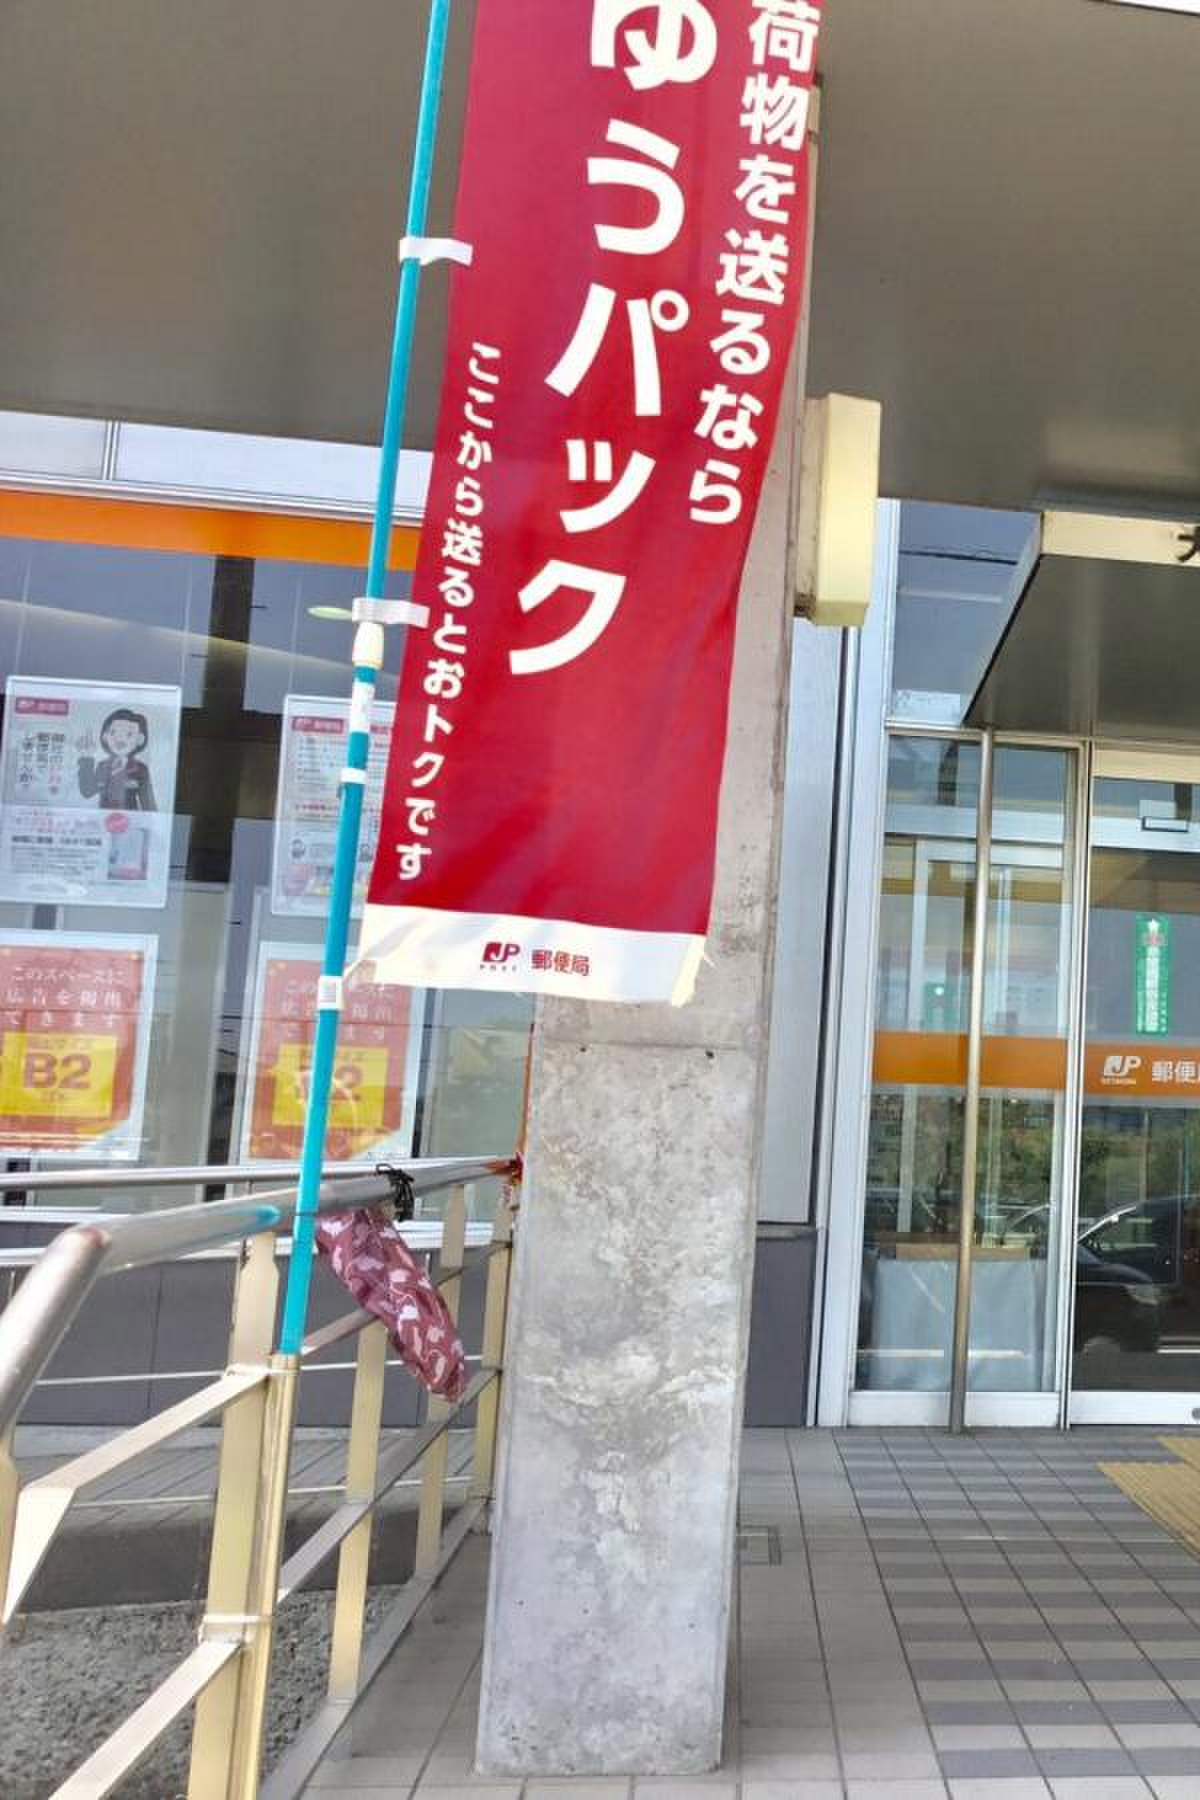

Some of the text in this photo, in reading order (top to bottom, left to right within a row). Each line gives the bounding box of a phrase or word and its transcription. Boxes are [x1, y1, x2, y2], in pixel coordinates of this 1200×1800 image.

[509, 0, 718, 675] ゆうパック
[689, 0, 821, 525] 荷物を送るなら
[396, 342, 501, 881] ここから送るとおトクです
[23, 1053, 92, 1089] B2
[531, 949, 590, 976] 郵便局
